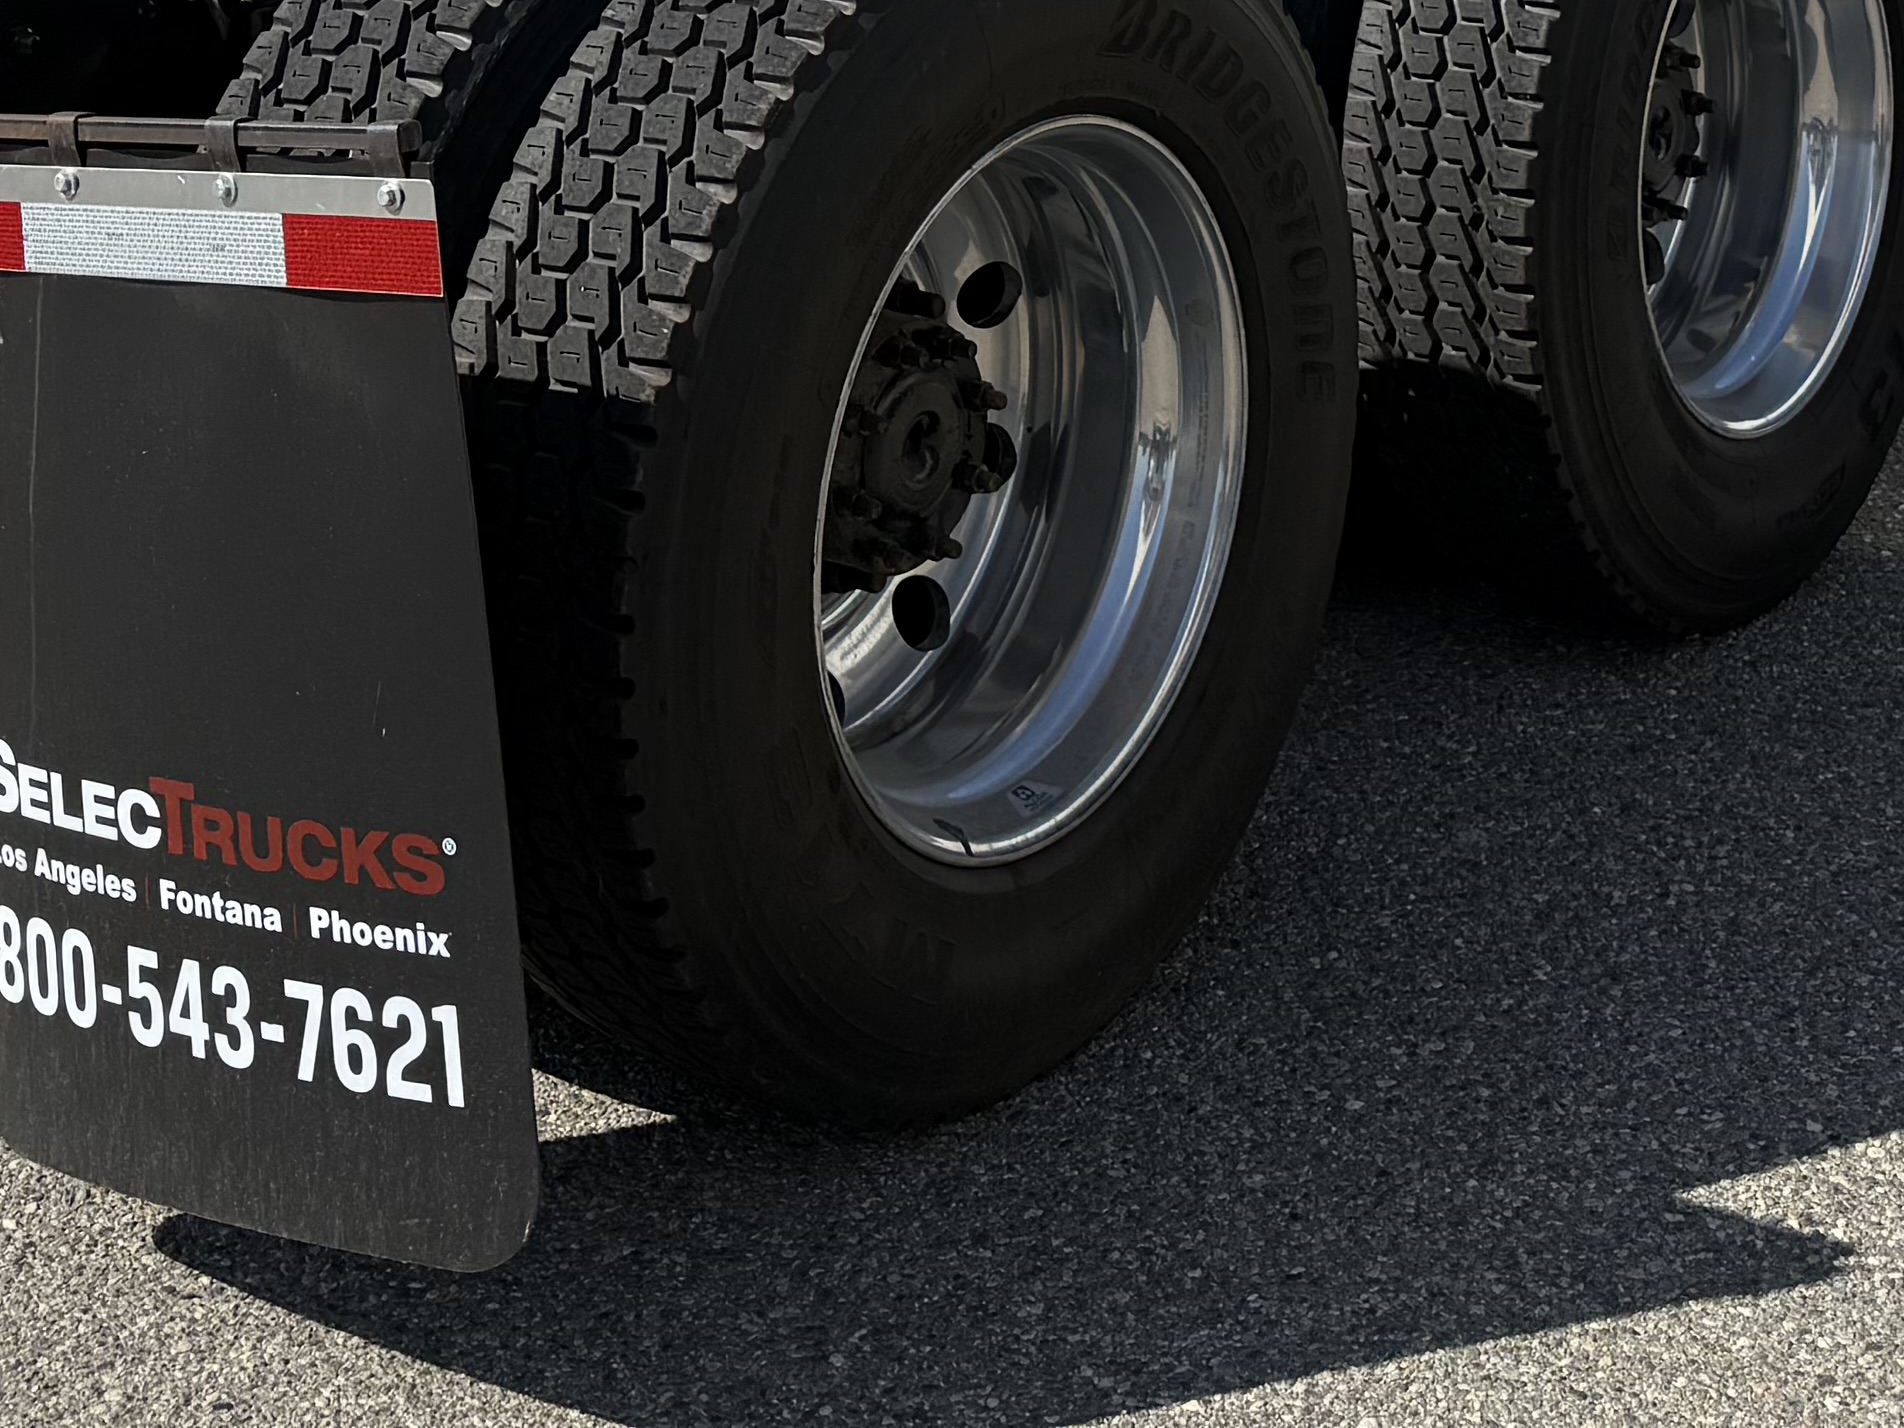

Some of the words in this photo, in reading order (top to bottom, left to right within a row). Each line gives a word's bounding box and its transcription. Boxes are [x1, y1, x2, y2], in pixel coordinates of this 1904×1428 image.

[33, 846, 137, 907] Angeles
[159, 877, 282, 934] Fontana
[309, 906, 452, 958] Phoenix
